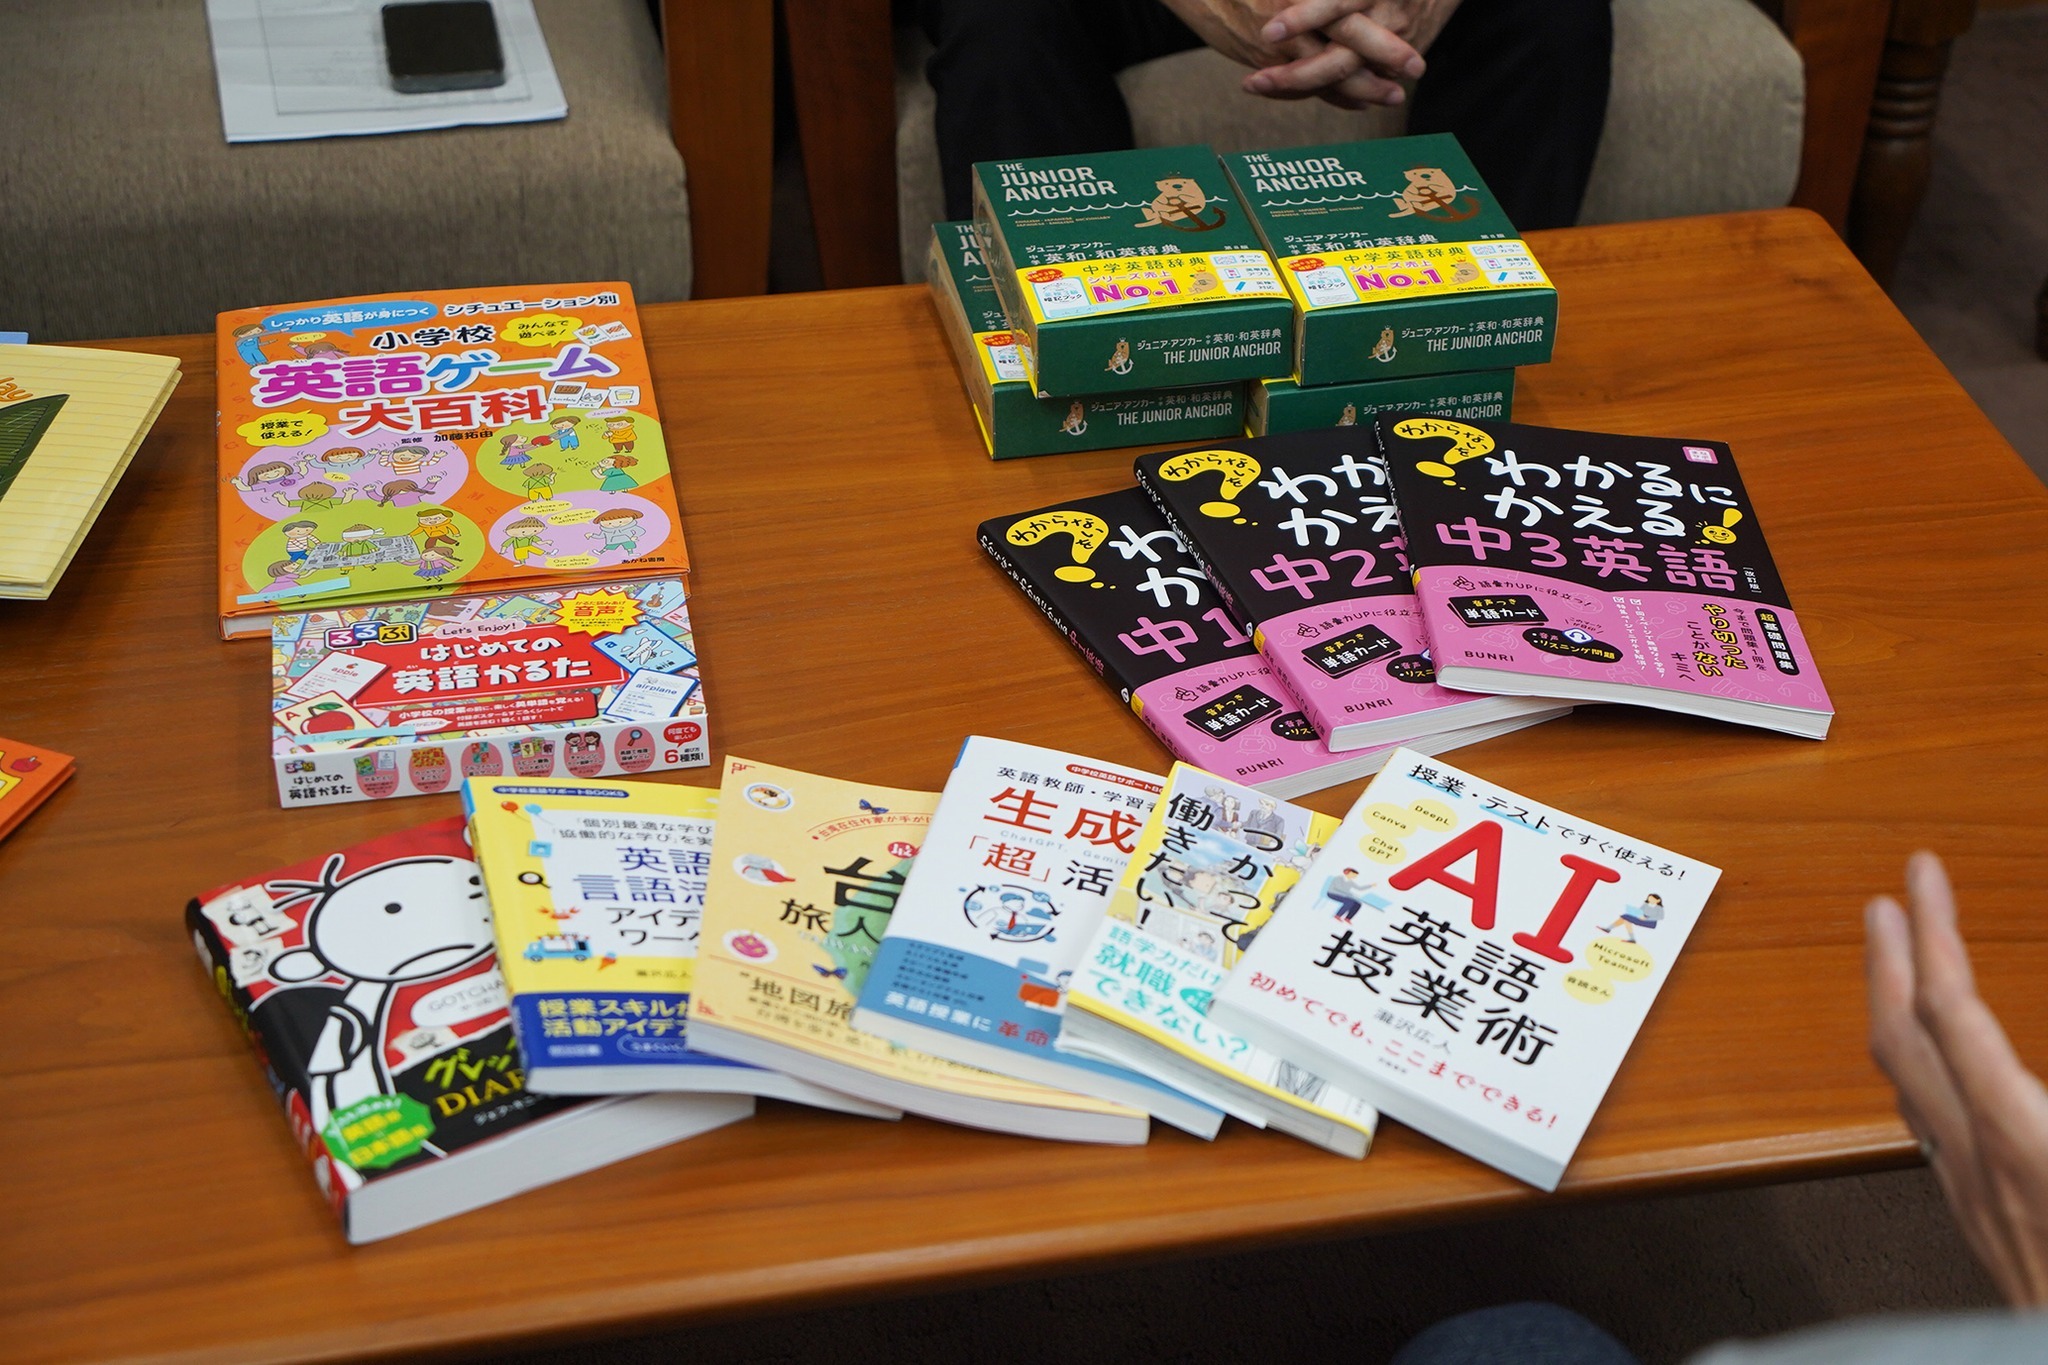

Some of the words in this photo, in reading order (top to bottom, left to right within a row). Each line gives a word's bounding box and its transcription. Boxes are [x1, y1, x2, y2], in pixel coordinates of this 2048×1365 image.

[996, 162, 1025, 171] THE
[1243, 154, 1272, 163] THE
[1249, 157, 1344, 178] JUNIOR
[1001, 166, 1096, 187] JUNIOR
[1256, 171, 1368, 193] ANCHOR
[1005, 180, 1118, 202] ANCHOR
[955, 225, 974, 234] TH
[1083, 257, 1206, 275] 中学英語辞典
[1343, 247, 1465, 264] 中学英語辞典
[1349, 259, 1433, 273] シリーズ売上
[1088, 271, 1172, 285] シリーズ売上
[1354, 268, 1443, 292] No.1
[1091, 278, 1181, 303] No.1
[447, 295, 617, 316] シチュエーション別
[270, 306, 429, 328] しっかり英語が身につく
[518, 319, 569, 329] みんなで
[1401, 325, 1466, 339] ジュニア・アンカー
[1476, 316, 1544, 332] 英和・和英辞典
[372, 325, 494, 350] 小学校
[1137, 337, 1202, 350] ジュニア・アンカー
[1213, 328, 1282, 344] 英和・和英辞典
[1427, 338, 1448, 352] THE
[1450, 333, 1492, 350] JUNIOR
[1494, 329, 1543, 345] ANCHOR
[1164, 351, 1185, 364] THE
[1188, 346, 1230, 362] JUNIOR
[1232, 341, 1281, 358] ANCHOR
[258, 347, 612, 404] 英語ゲーム
[1091, 399, 1155, 412] ジュニア・アンカー
[1437, 391, 1503, 407] 英和・和英辞典
[346, 389, 547, 435] 大百科
[1117, 412, 1139, 425] THE
[1141, 407, 1182, 423] JUNIOR
[1184, 402, 1233, 419] ANCHOR
[1456, 404, 1502, 419] ANCHOR
[260, 419, 304, 431] 授業で
[1400, 422, 1488, 458] わからないを
[1164, 453, 1256, 489] わからないを
[1484, 448, 1738, 507] わかるに
[1483, 486, 1687, 537] かえる
[1011, 515, 1104, 550] わからないを
[621, 556, 665, 565] あかね書房
[1435, 516, 1739, 591] 中3英語
[1465, 607, 1540, 620] 単語カード
[1472, 598, 1517, 607] 音声つき
[330, 624, 411, 645] るるぶ
[442, 626, 473, 636] Let's
[477, 622, 516, 634] Enjoy!
[1538, 632, 1559, 641] 音声
[1702, 603, 1749, 670] やり切った
[420, 637, 562, 662] はじめての
[1324, 632, 1366, 654] 音声つき
[1538, 640, 1616, 660] リスニング問題
[1687, 620, 1724, 678] ことがない
[1759, 612, 1796, 671] 超基礎問題集
[1322, 637, 1391, 669] 単語カード
[1464, 650, 1515, 662] BUNRI
[331, 666, 359, 678] apple
[392, 657, 591, 694] 英語かるた
[1401, 661, 1422, 669] 音声
[1671, 651, 1696, 682] キミへ
[635, 682, 678, 695] airplane
[285, 711, 301, 721] A
[1204, 697, 1271, 732] 単語カード
[1205, 694, 1244, 717] 音声つき
[1344, 698, 1393, 713] BUNRI
[664, 749, 678, 764] 6
[1236, 758, 1285, 776] BUNRI
[293, 775, 344, 785] はじめての
[289, 785, 353, 799] 英語かるた
[983, 787, 1143, 854] 生成
[1372, 810, 1407, 830] Canva
[1409, 763, 1687, 882] 授業・テストですぐ使える!
[1414, 804, 1450, 826] DeepL
[1368, 845, 1392, 860] GPT
[1372, 836, 1399, 853] Chat
[616, 847, 711, 876] 英語
[1136, 792, 1215, 931] 働きたい!
[1209, 827, 1284, 945] つかって
[1388, 819, 1621, 964] AI
[605, 906, 700, 927] アイデ
[780, 898, 881, 945] 旅人
[1381, 906, 1546, 1004] 英語
[1593, 942, 1650, 968] Microsoft
[1598, 955, 1635, 974] Teams
[1093, 944, 1176, 998] 就職
[1313, 930, 1560, 1065] 授業術
[1088, 967, 1249, 1060] できない?
[1248, 969, 1560, 1130] 初めてでも、ここまでできる!
[423, 1036, 518, 1090] グレッ
